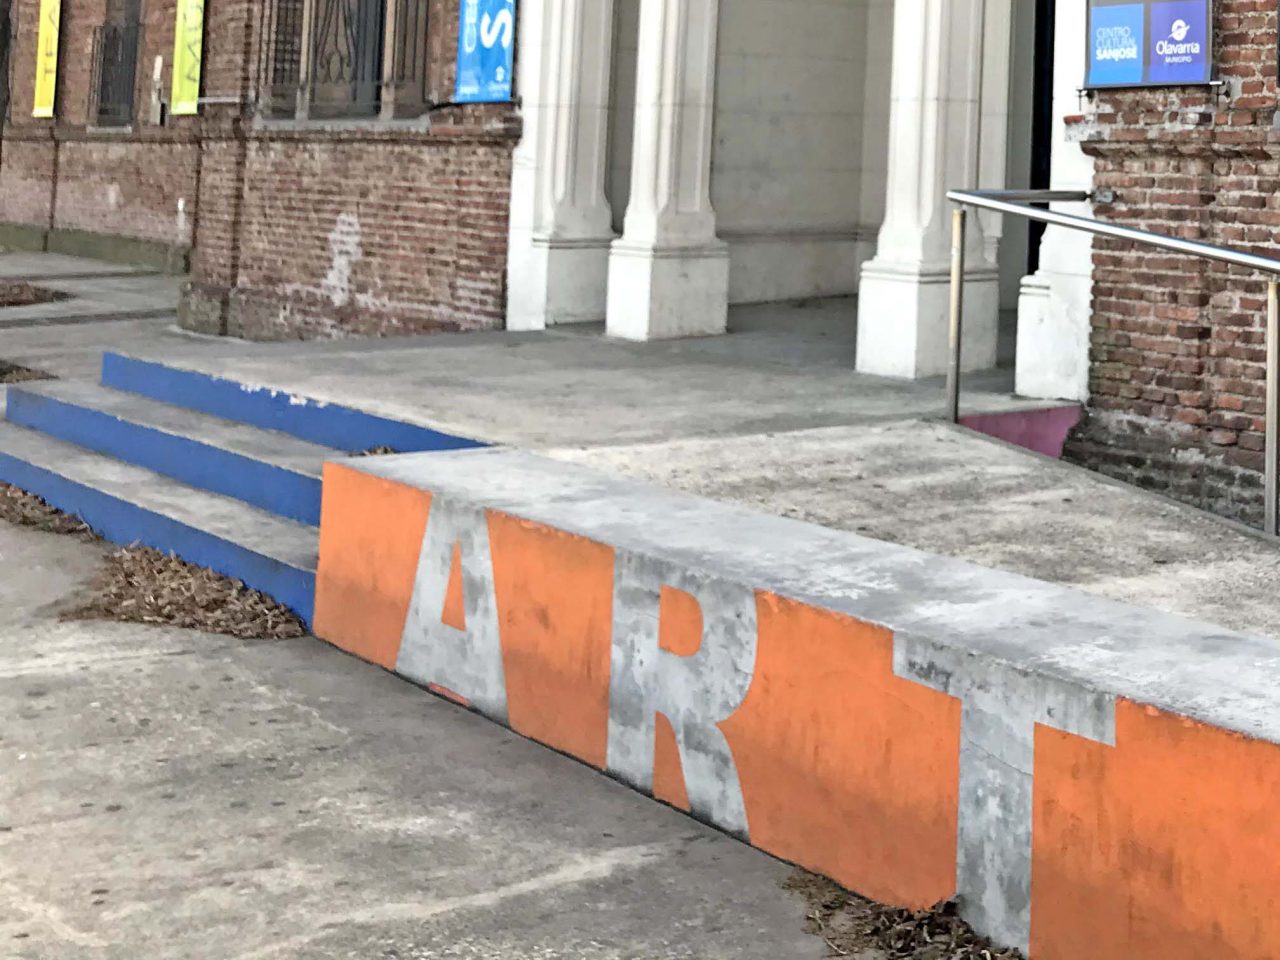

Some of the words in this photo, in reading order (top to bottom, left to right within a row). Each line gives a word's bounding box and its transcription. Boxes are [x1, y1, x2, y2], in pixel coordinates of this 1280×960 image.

[1096, 26, 1131, 38] CENTRO
[1096, 37, 1136, 48] CULTURAL
[1096, 47, 1138, 61] SANJOSE
[1165, 56, 1192, 64] MUNICIPIO
